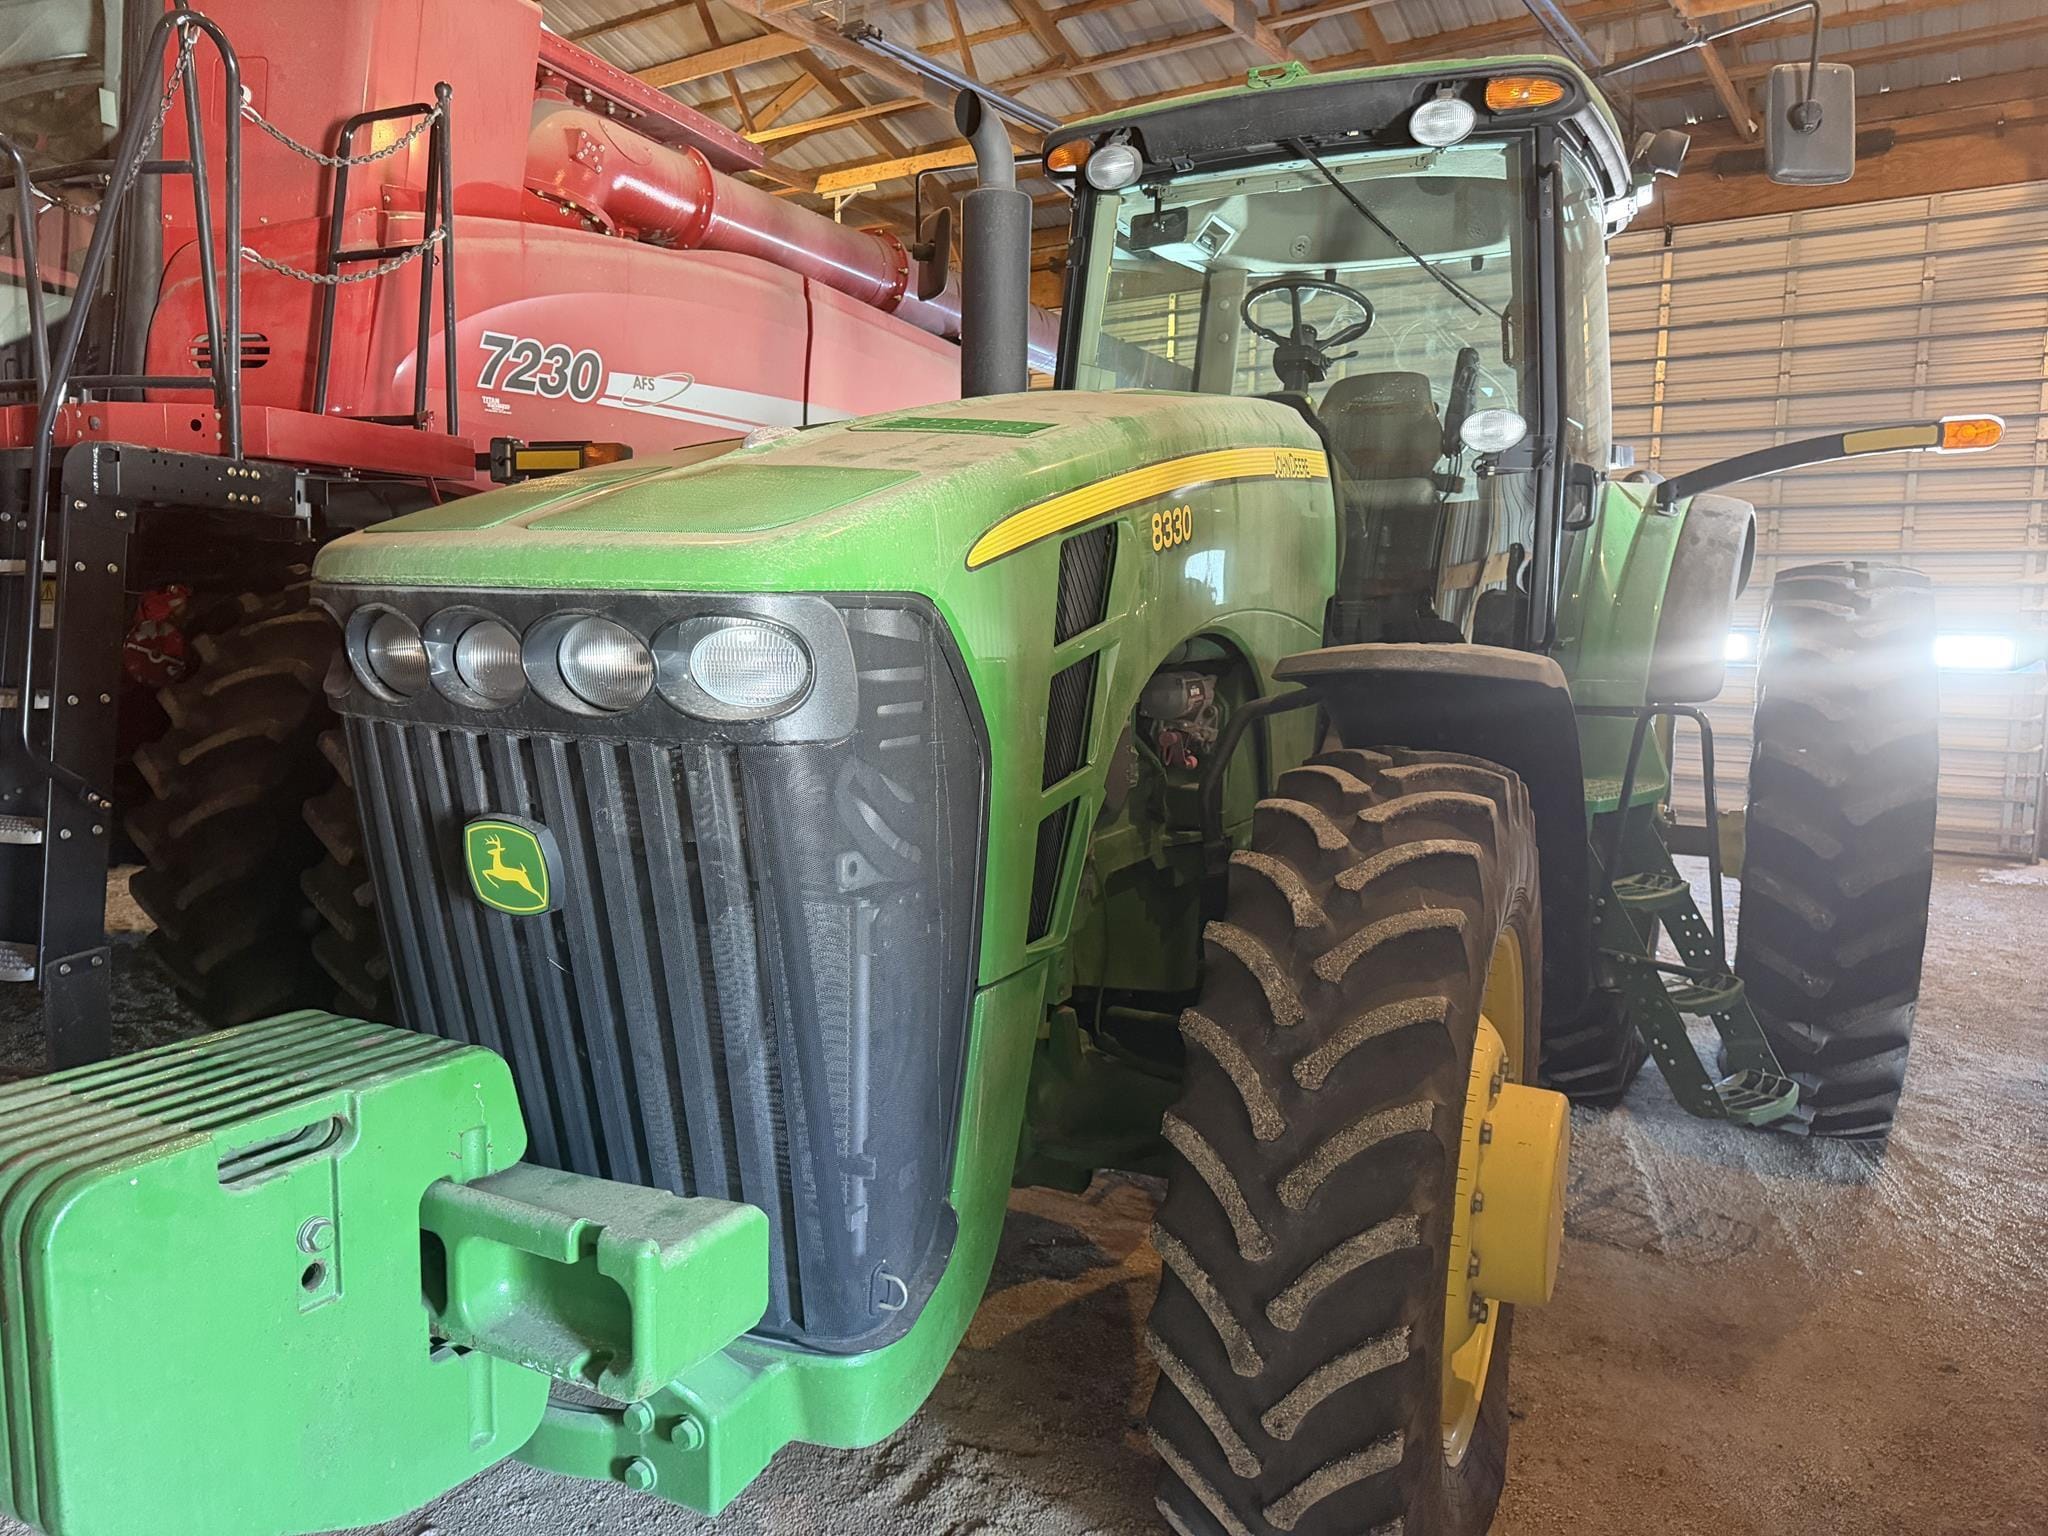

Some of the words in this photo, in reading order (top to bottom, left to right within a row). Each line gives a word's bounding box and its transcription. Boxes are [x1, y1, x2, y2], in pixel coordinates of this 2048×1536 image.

[477, 330, 603, 403] 7230
[633, 375, 656, 391] AFS
[1151, 504, 1192, 552] 8330
